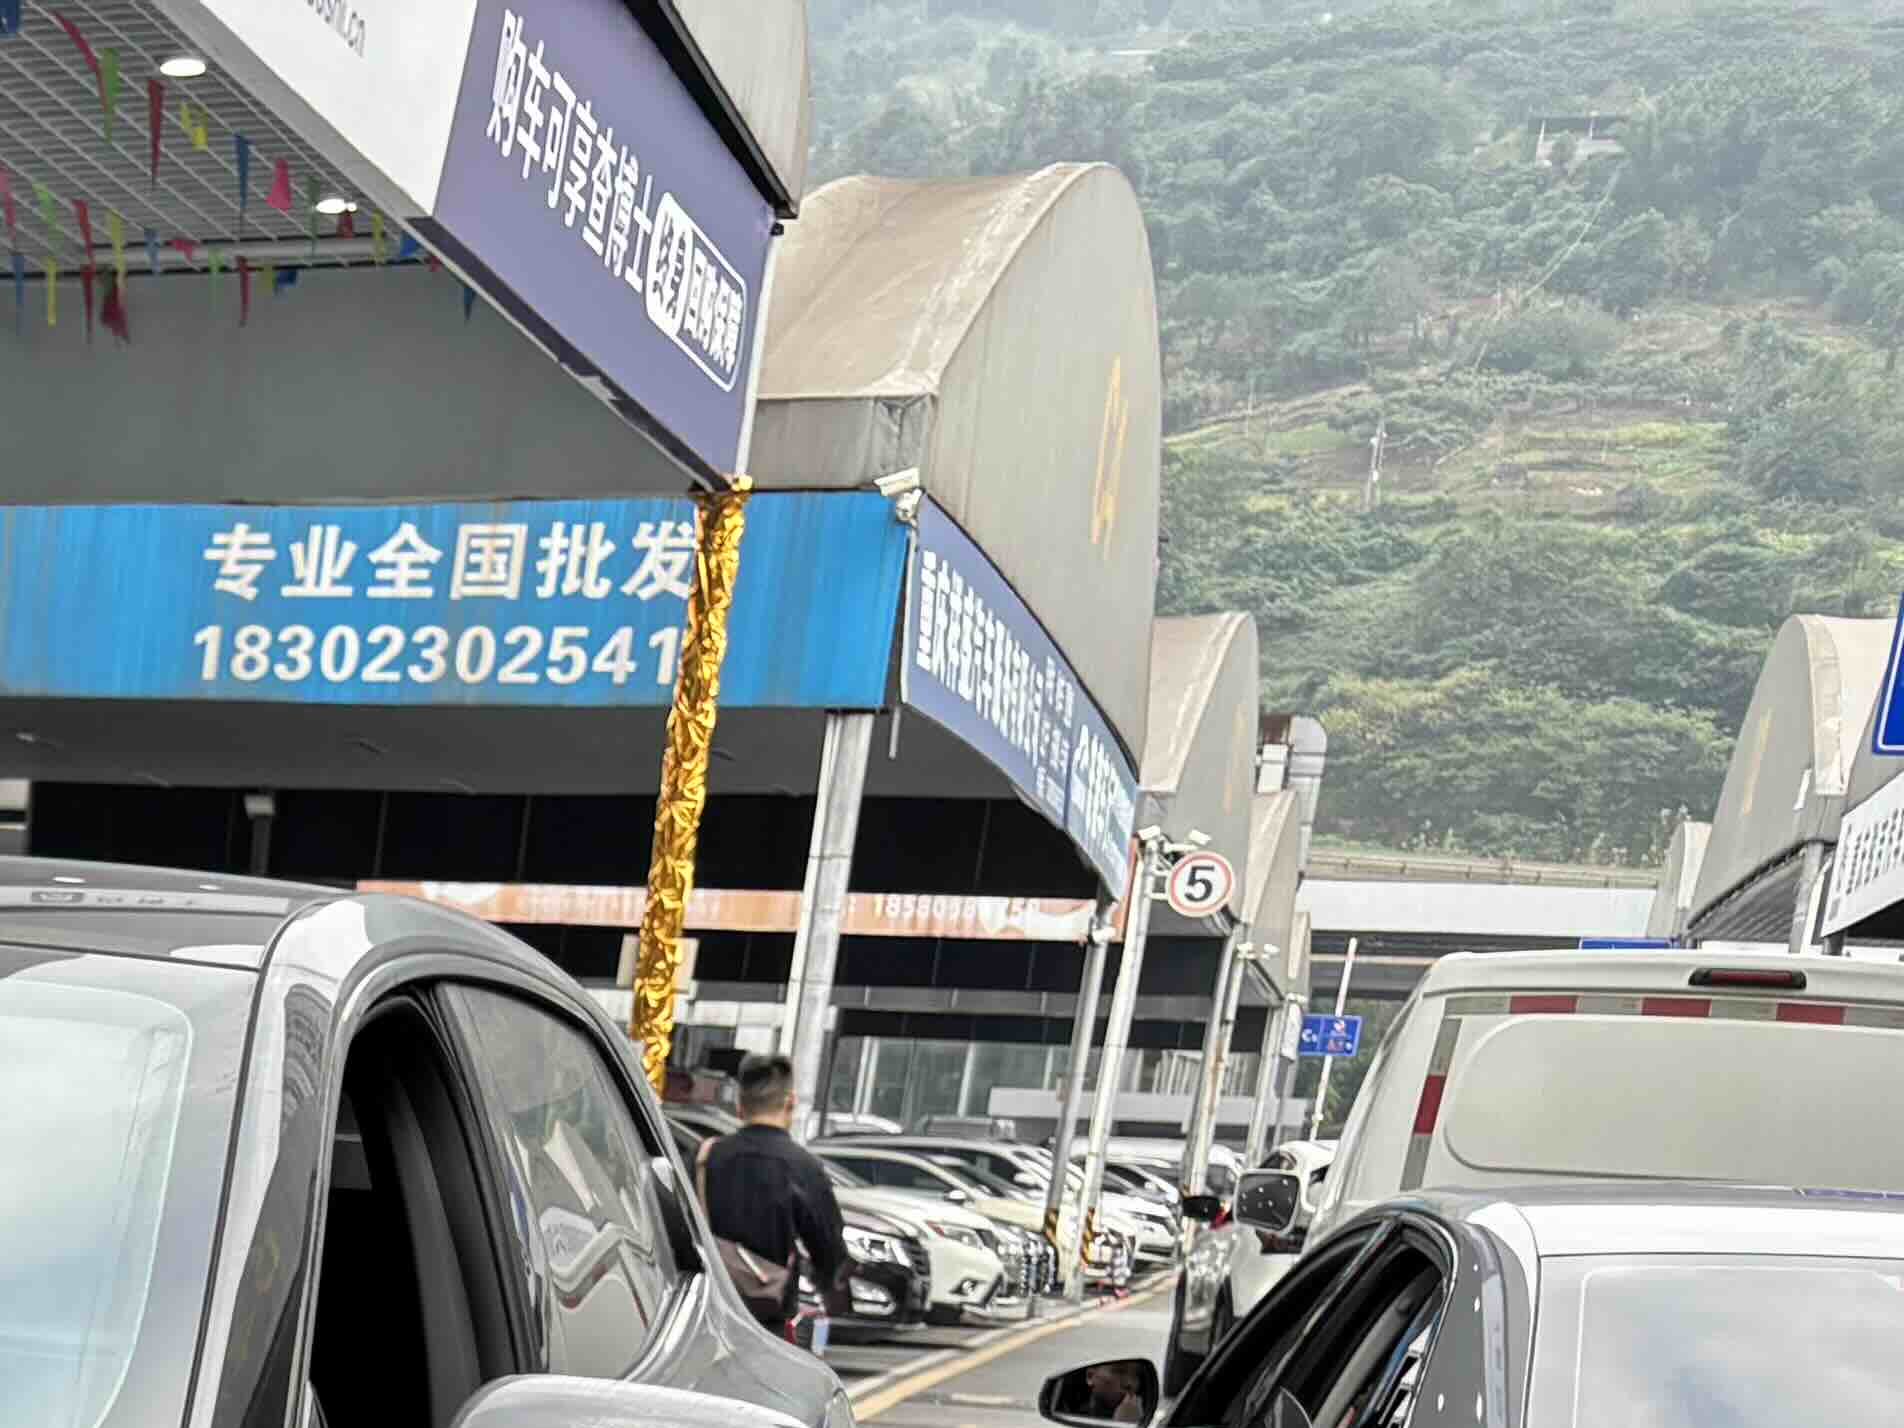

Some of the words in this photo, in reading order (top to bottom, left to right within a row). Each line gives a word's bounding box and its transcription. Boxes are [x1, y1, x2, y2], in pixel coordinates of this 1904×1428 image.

[487, 9, 652, 293] 购车可享查博士
[203, 521, 700, 601] 专业全国批发
[192, 624, 684, 686] 18302302541
[1185, 864, 1216, 903] 5
